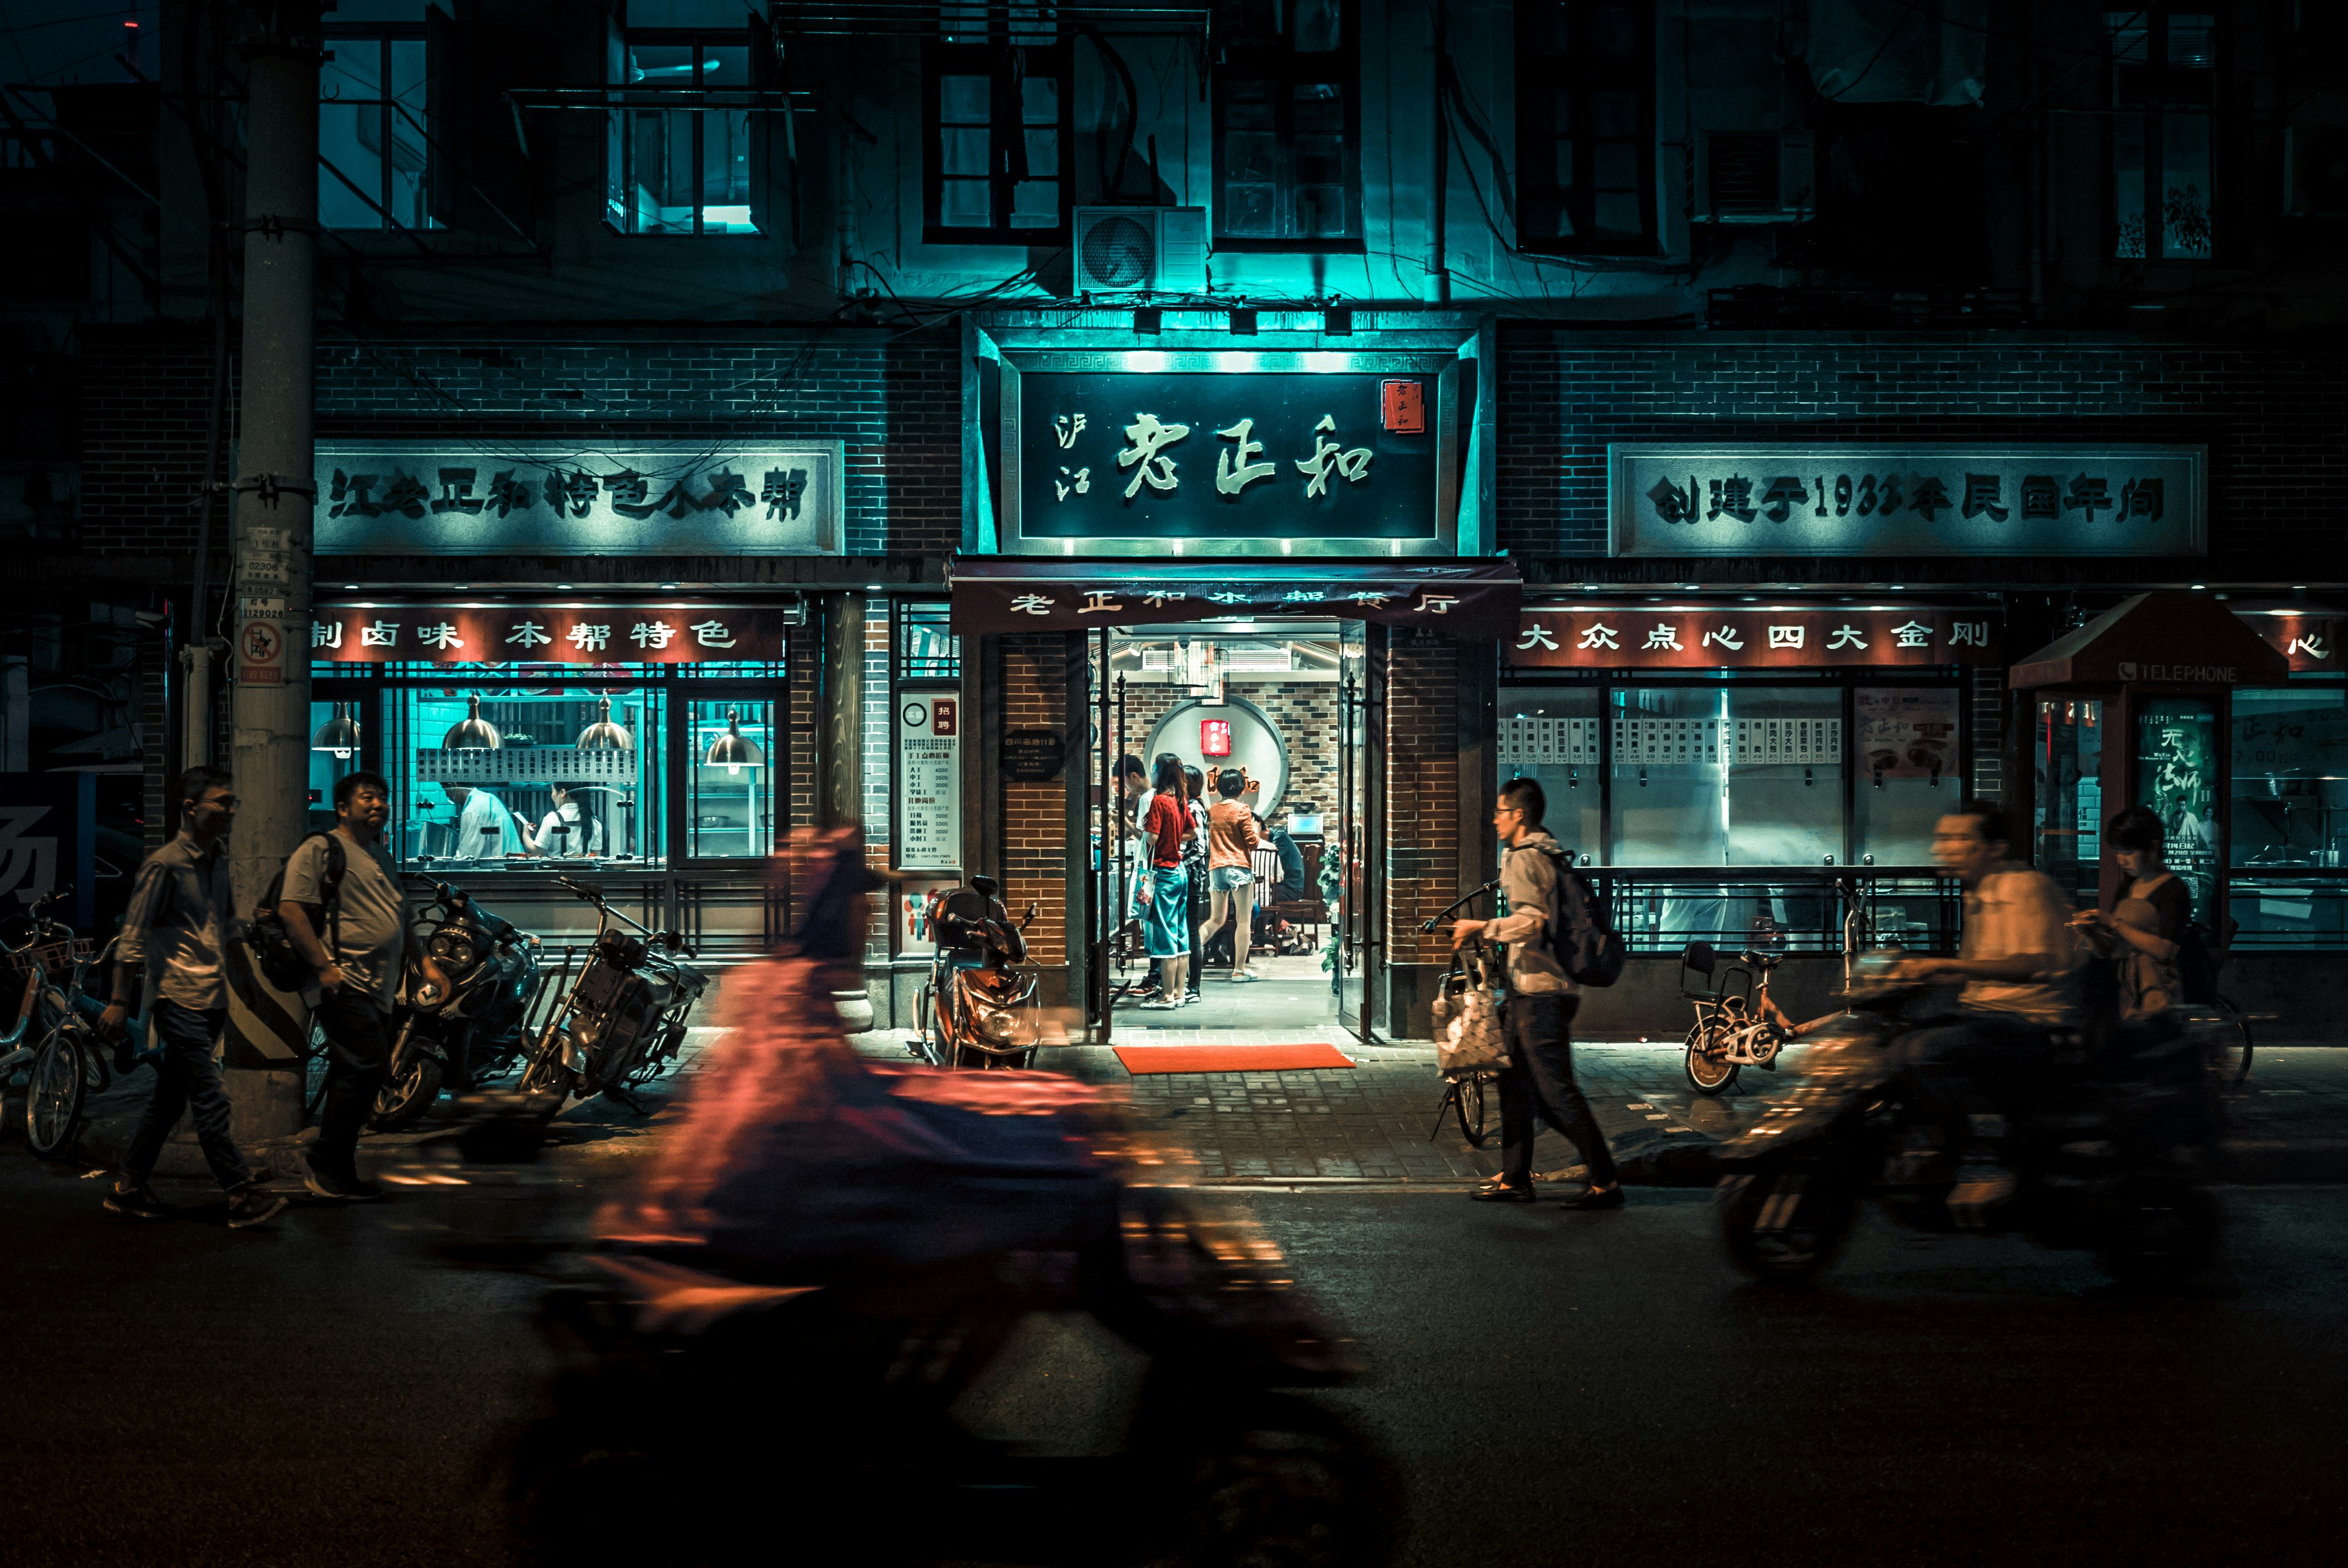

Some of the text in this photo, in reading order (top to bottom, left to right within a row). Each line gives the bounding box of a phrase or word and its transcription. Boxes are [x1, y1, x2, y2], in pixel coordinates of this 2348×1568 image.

[1055, 413, 1090, 501] 沪江
[1116, 413, 1374, 499] 老正和
[249, 562, 278, 571] 02306
[1010, 590, 1460, 615] 老正和本帮餐厅
[505, 619, 737, 652] 本帮特色
[2140, 664, 2238, 683] TELEPHONE
[938, 707, 951, 730] 招聘
